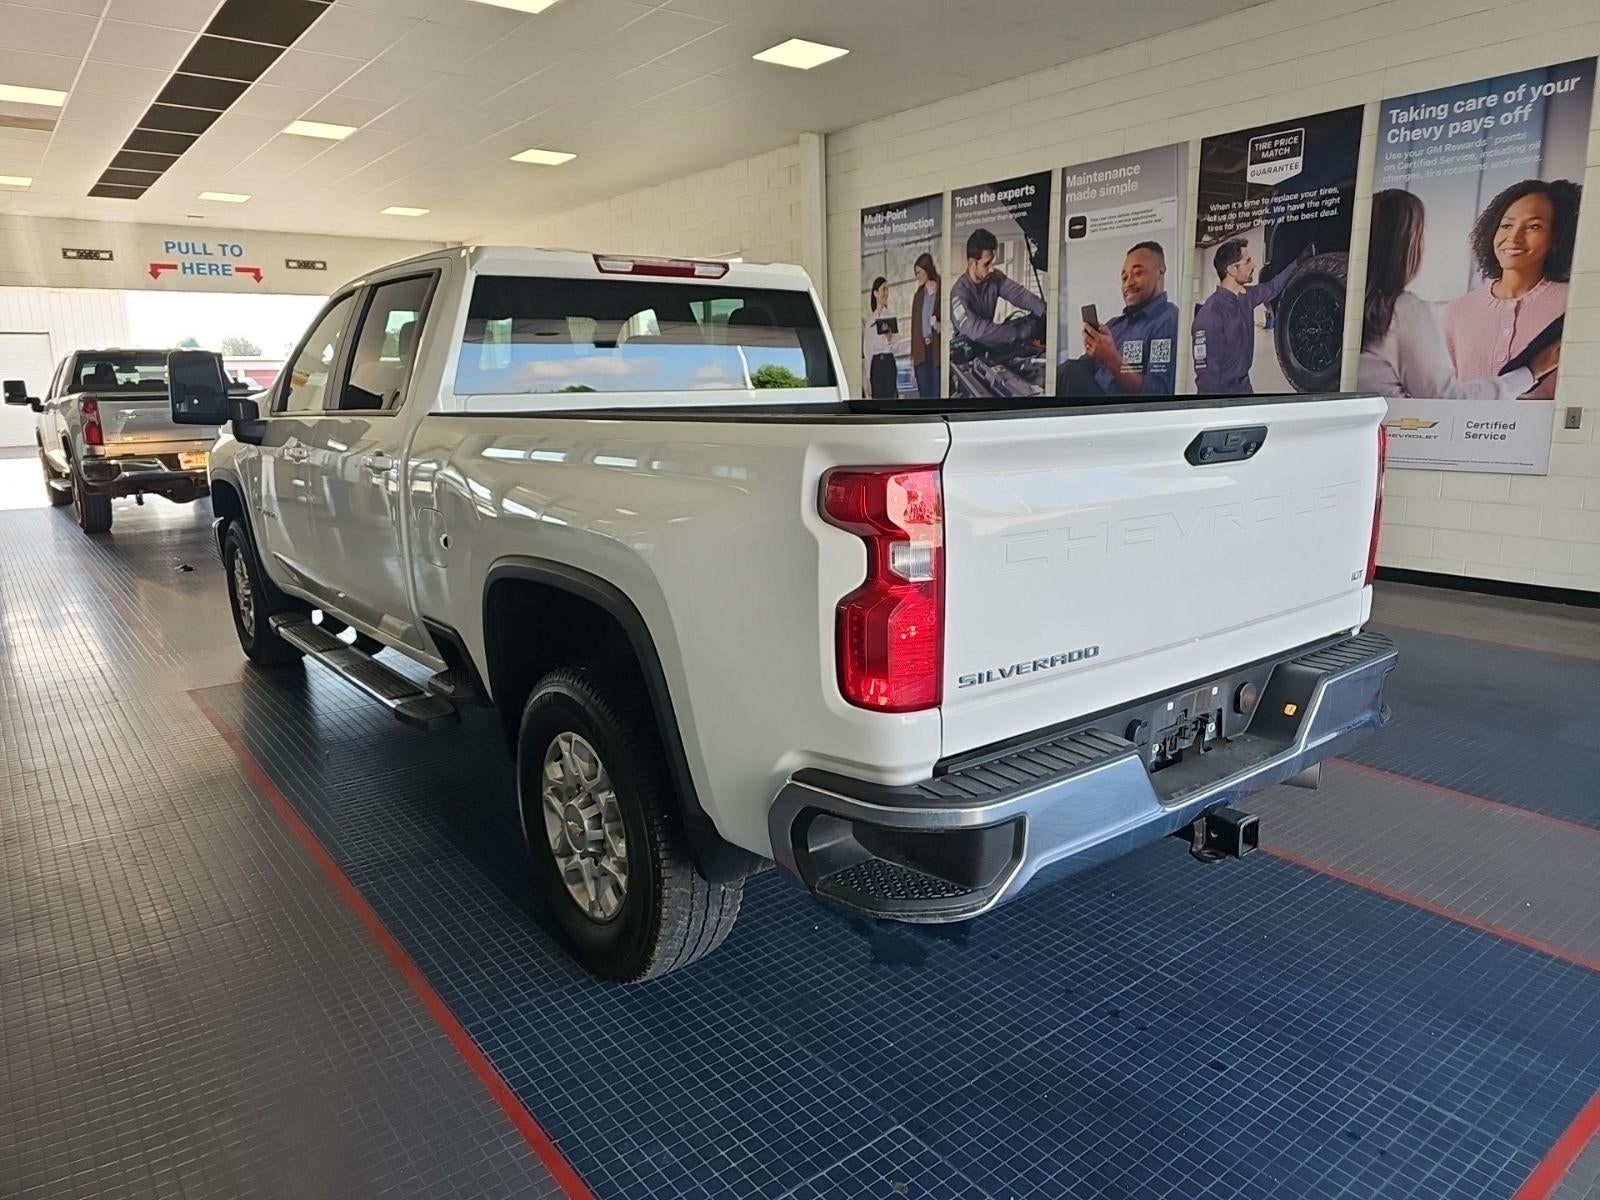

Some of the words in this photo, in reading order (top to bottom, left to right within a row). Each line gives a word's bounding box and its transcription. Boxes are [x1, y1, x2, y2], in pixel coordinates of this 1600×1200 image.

[1389, 103, 1449, 125] Taking
[1454, 93, 1498, 113] care
[1503, 83, 1527, 104] of
[1530, 76, 1581, 104] your
[1387, 122, 1444, 144] Chevy
[1448, 115, 1495, 138] pays
[1500, 103, 1533, 126] off
[1254, 141, 1272, 151] TIRE
[1274, 135, 1300, 148] PRICE
[1261, 147, 1291, 159] MATCH
[1385, 151, 1403, 161] Use
[1404, 149, 1424, 160] your
[1426, 145, 1443, 156] GM
[1494, 131, 1528, 146] points
[1383, 164, 1395, 172] on
[1397, 157, 1437, 171] Certified
[1480, 144, 1525, 160] including
[1528, 140, 1541, 151] oil
[1066, 164, 1141, 188] Maintenance
[1250, 162, 1300, 178] GUARANTEE
[955, 193, 978, 208] Trust
[980, 191, 995, 204] the
[997, 184, 1036, 202] experts
[1066, 188, 1097, 203] made
[1099, 179, 1139, 197] simple
[1210, 201, 1231, 212] When
[1244, 198, 1260, 208] time
[1261, 197, 1270, 205] to
[1271, 192, 1299, 206] replace
[1300, 190, 1318, 201] your
[864, 208, 907, 225] Multi-Point
[1217, 213, 1227, 221] us
[1228, 211, 1237, 220] do
[1238, 209, 1250, 219] the
[1273, 205, 1286, 215] We
[1287, 201, 1305, 212] have
[1306, 199, 1320, 209] the
[1321, 195, 1341, 209] right
[864, 224, 891, 237] Vehicle
[892, 216, 935, 233] Inspection
[1207, 222, 1223, 232] tires
[1224, 220, 1236, 230] for
[1236, 219, 1252, 232] your
[1252, 216, 1276, 229] Chevy
[1277, 214, 1285, 224] at
[1286, 212, 1300, 222] the
[1301, 209, 1319, 220] best
[164, 240, 213, 256] PULL
[218, 243, 243, 257] TO
[182, 262, 233, 277] HERE
[1464, 431, 1507, 441] Service
[1466, 420, 1516, 431] Certified
[999, 480, 1362, 571] CHEVROLET
[958, 645, 1099, 689] SILVERADO
